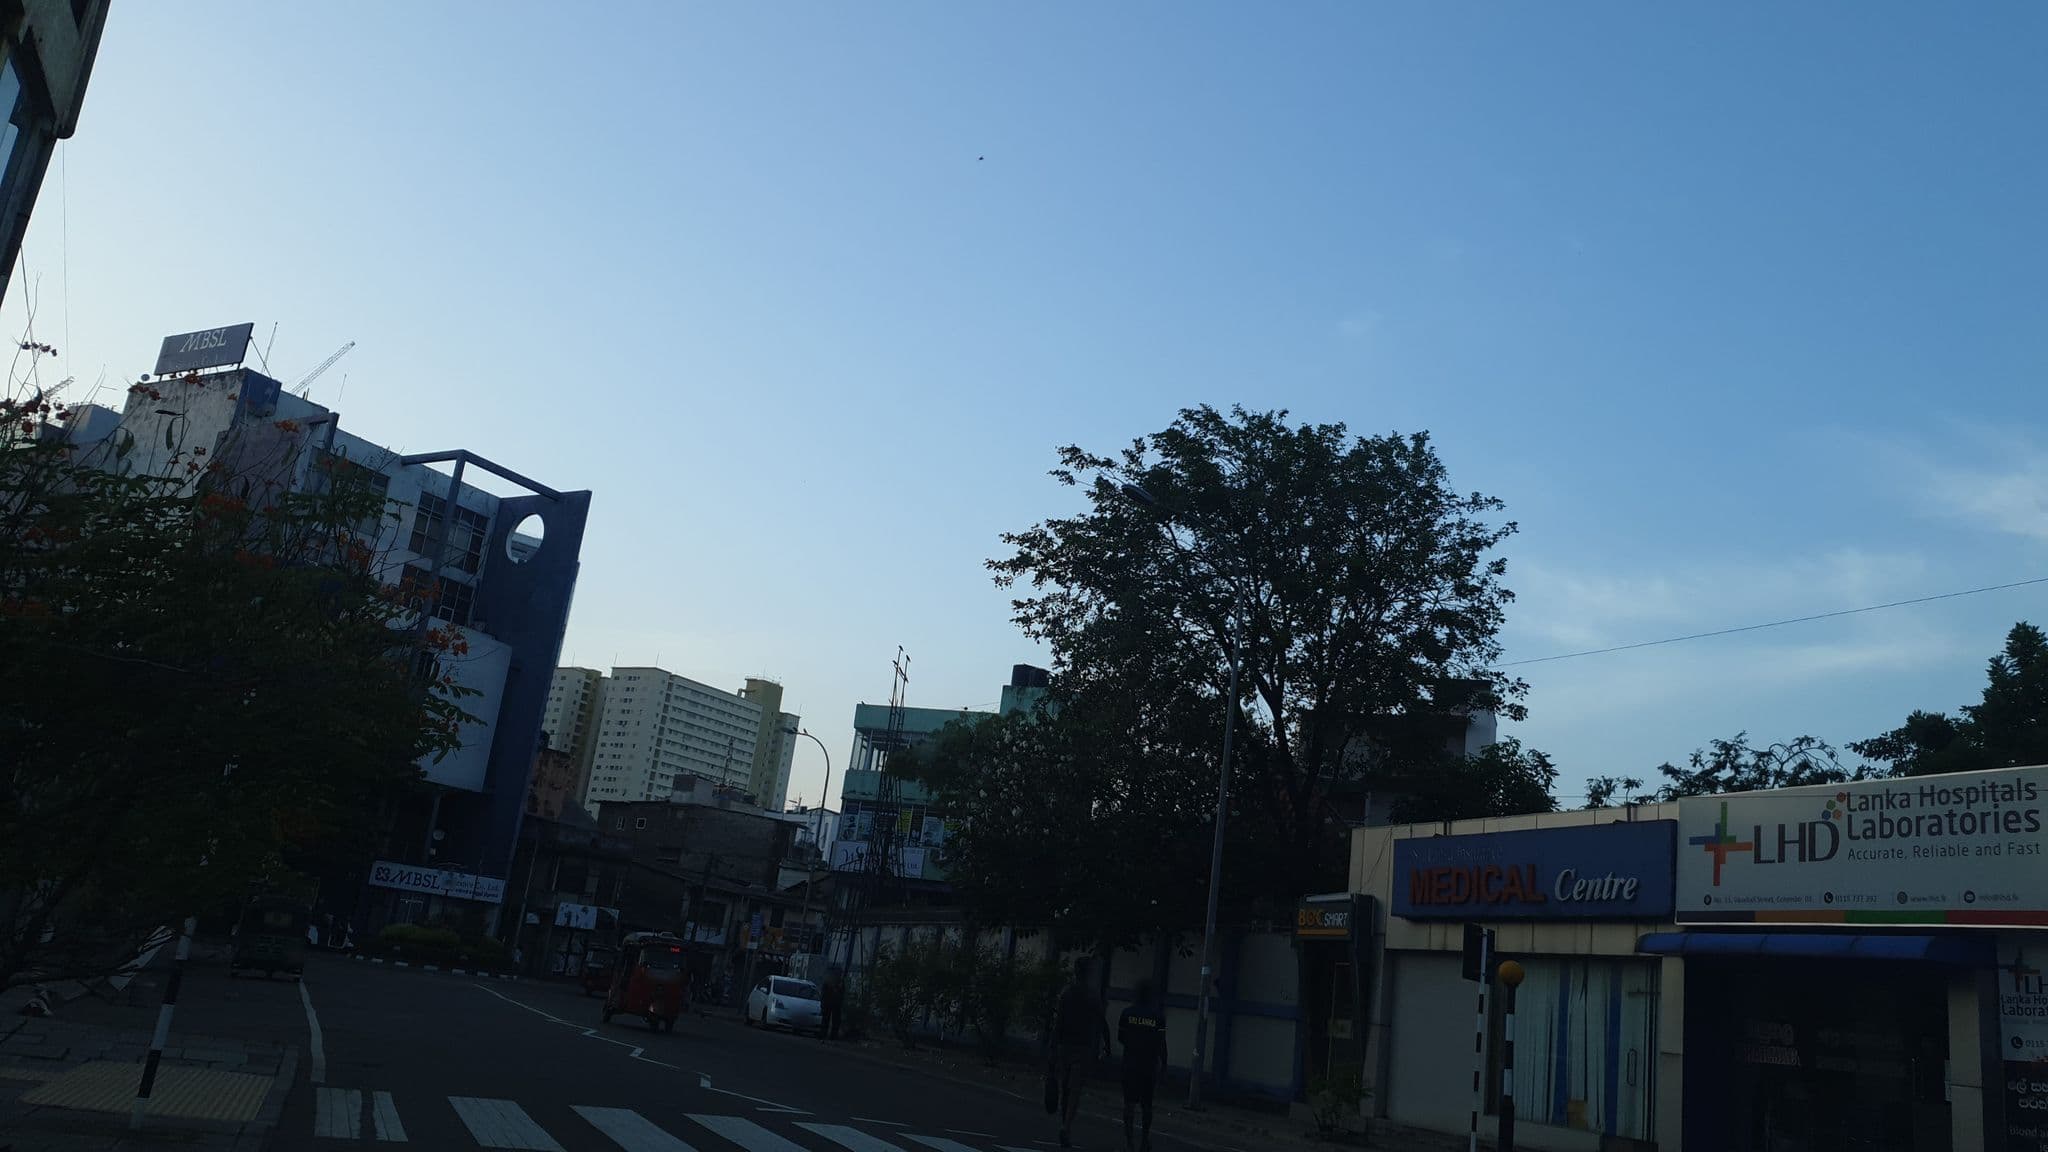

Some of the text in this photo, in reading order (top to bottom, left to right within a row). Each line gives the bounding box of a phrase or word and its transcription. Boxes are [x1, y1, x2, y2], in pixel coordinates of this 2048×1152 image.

[179, 328, 227, 353] MBSL
[1846, 778, 2038, 813] Lanka Hospitals
[1847, 800, 2040, 841] Laboratories
[1753, 820, 1840, 865] LHD
[1847, 840, 2041, 861] Accurate, Reliable and Fast
[389, 869, 441, 890] MBSL
[1408, 863, 1639, 905] MEDICAL Centre
[1298, 908, 1348, 928] BOC SMART
[2000, 994, 2031, 1005] Lanka
